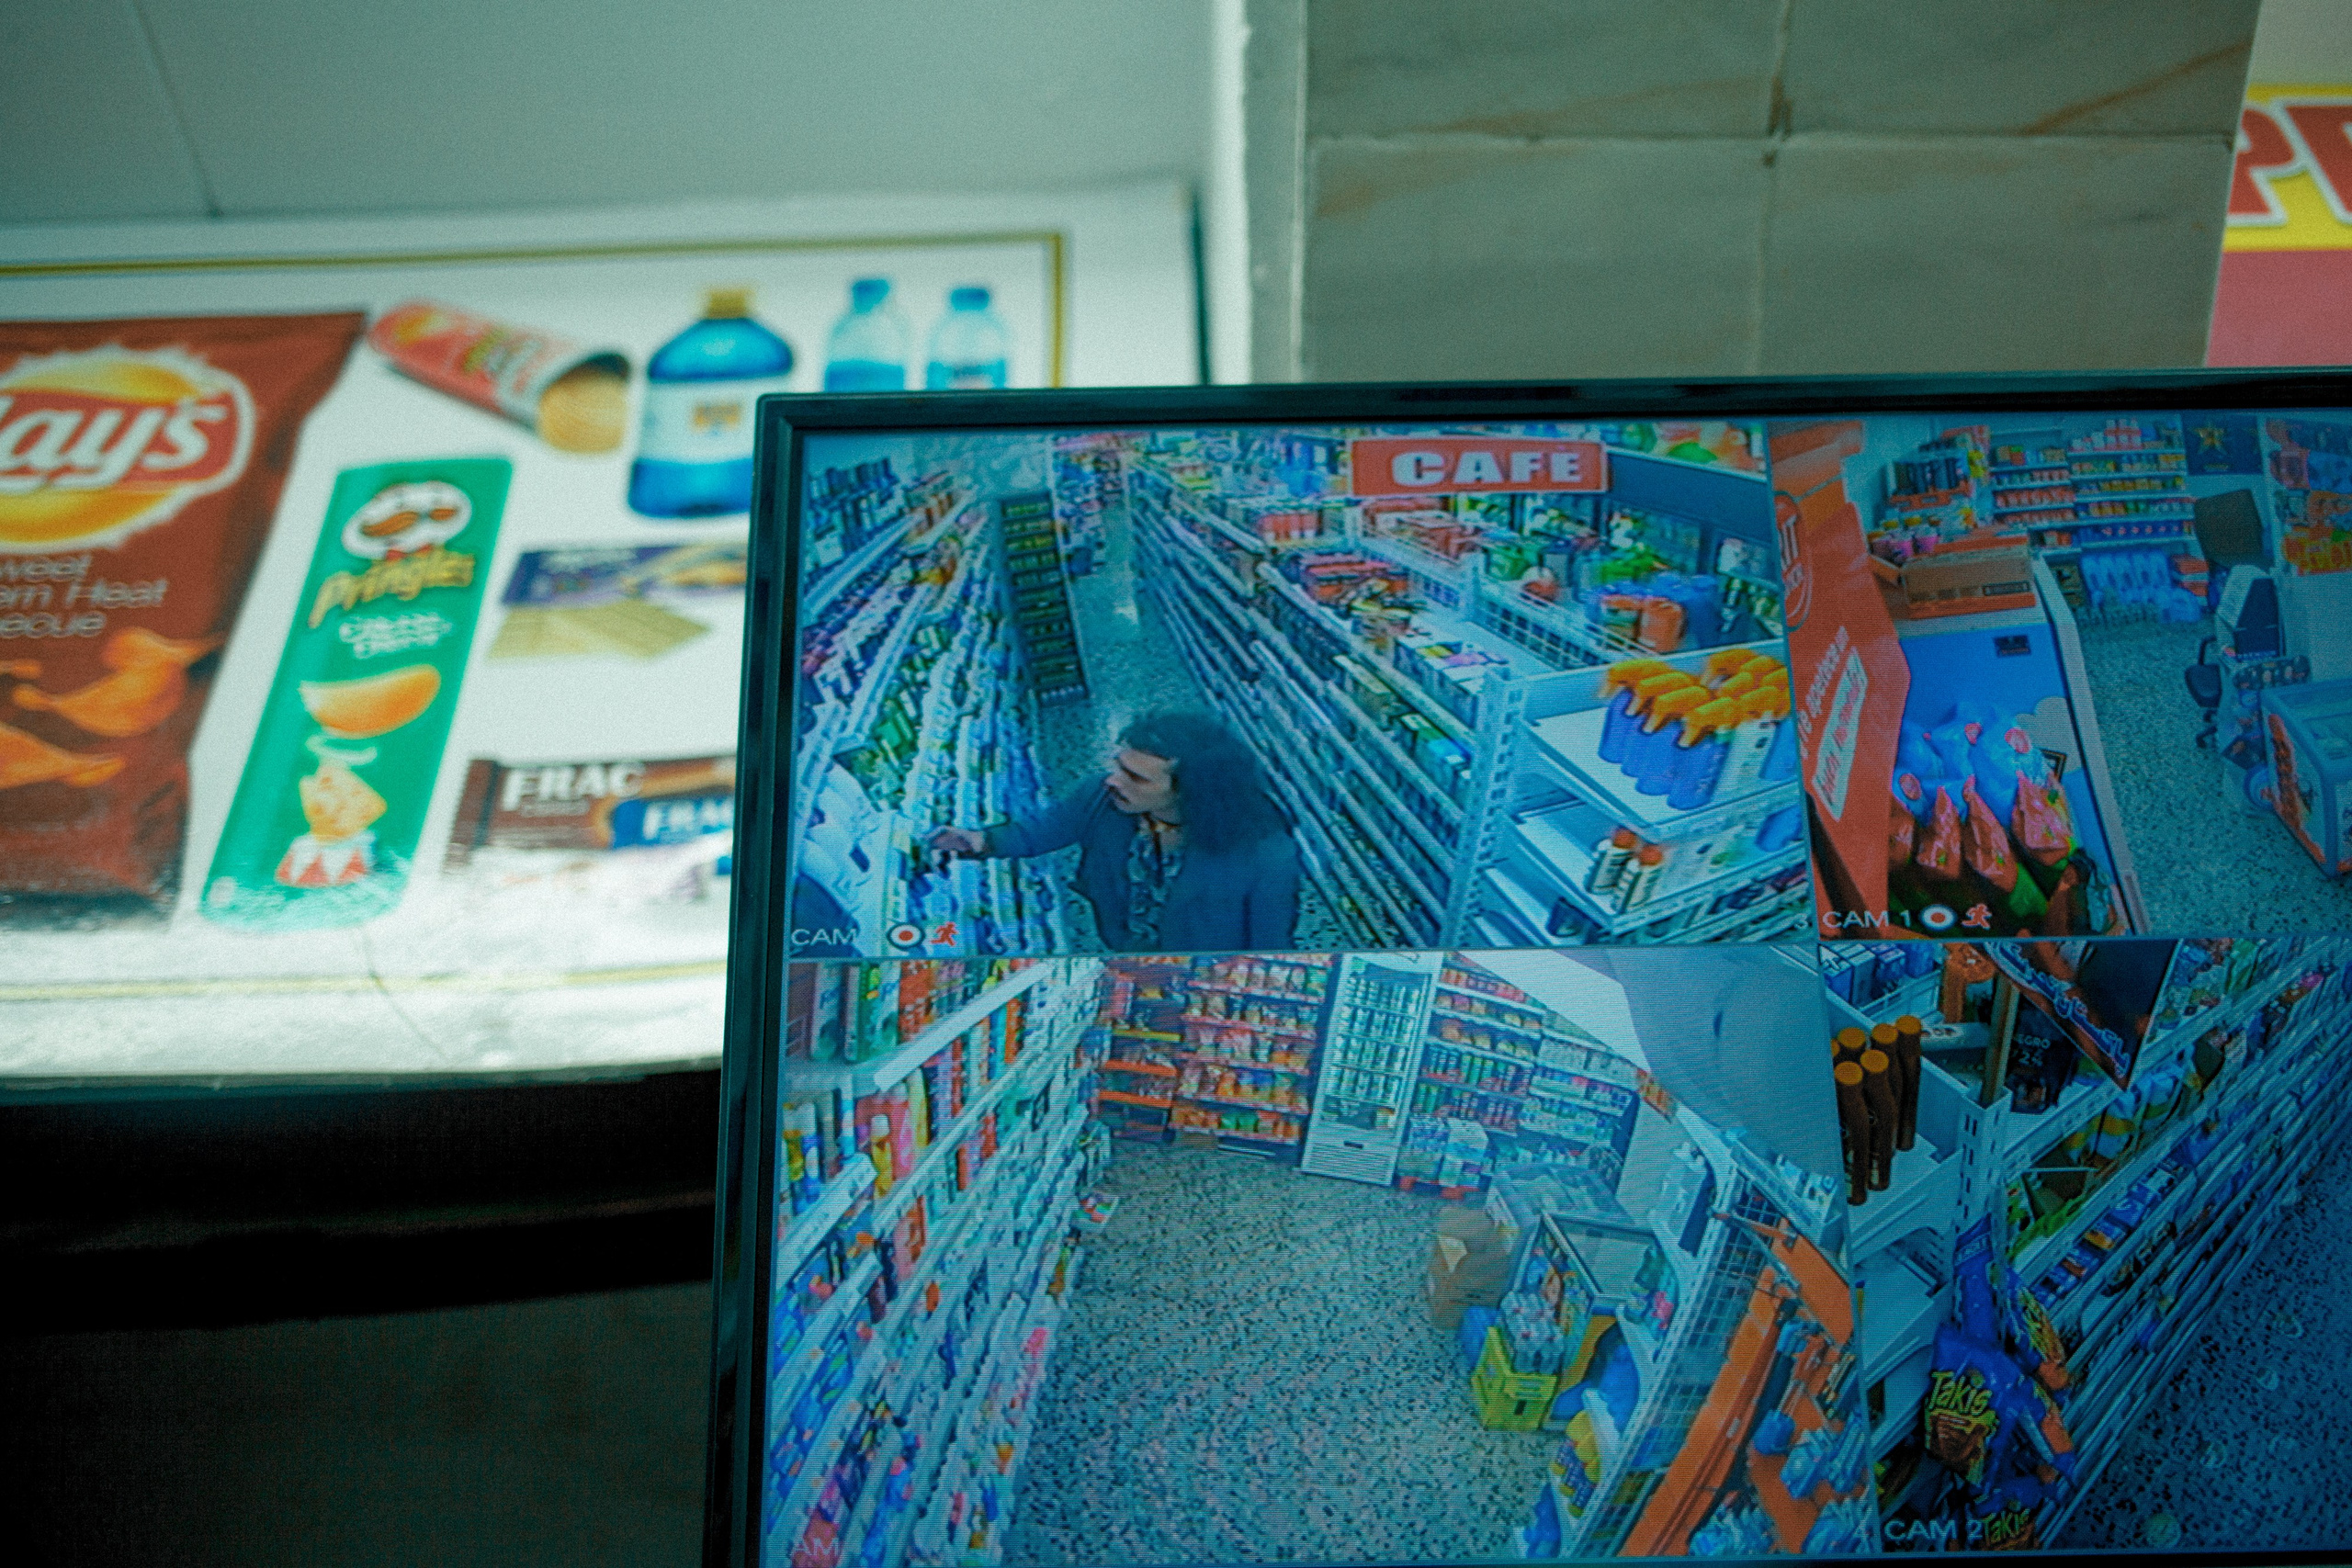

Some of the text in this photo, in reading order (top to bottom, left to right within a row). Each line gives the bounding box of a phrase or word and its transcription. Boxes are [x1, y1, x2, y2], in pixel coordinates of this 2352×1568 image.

[1822, 909, 1911, 929] CAM 1
[790, 928, 857, 947] CAM
[1929, 1371, 1993, 1416] Takis
[1883, 1519, 1983, 1540] CAM 2
